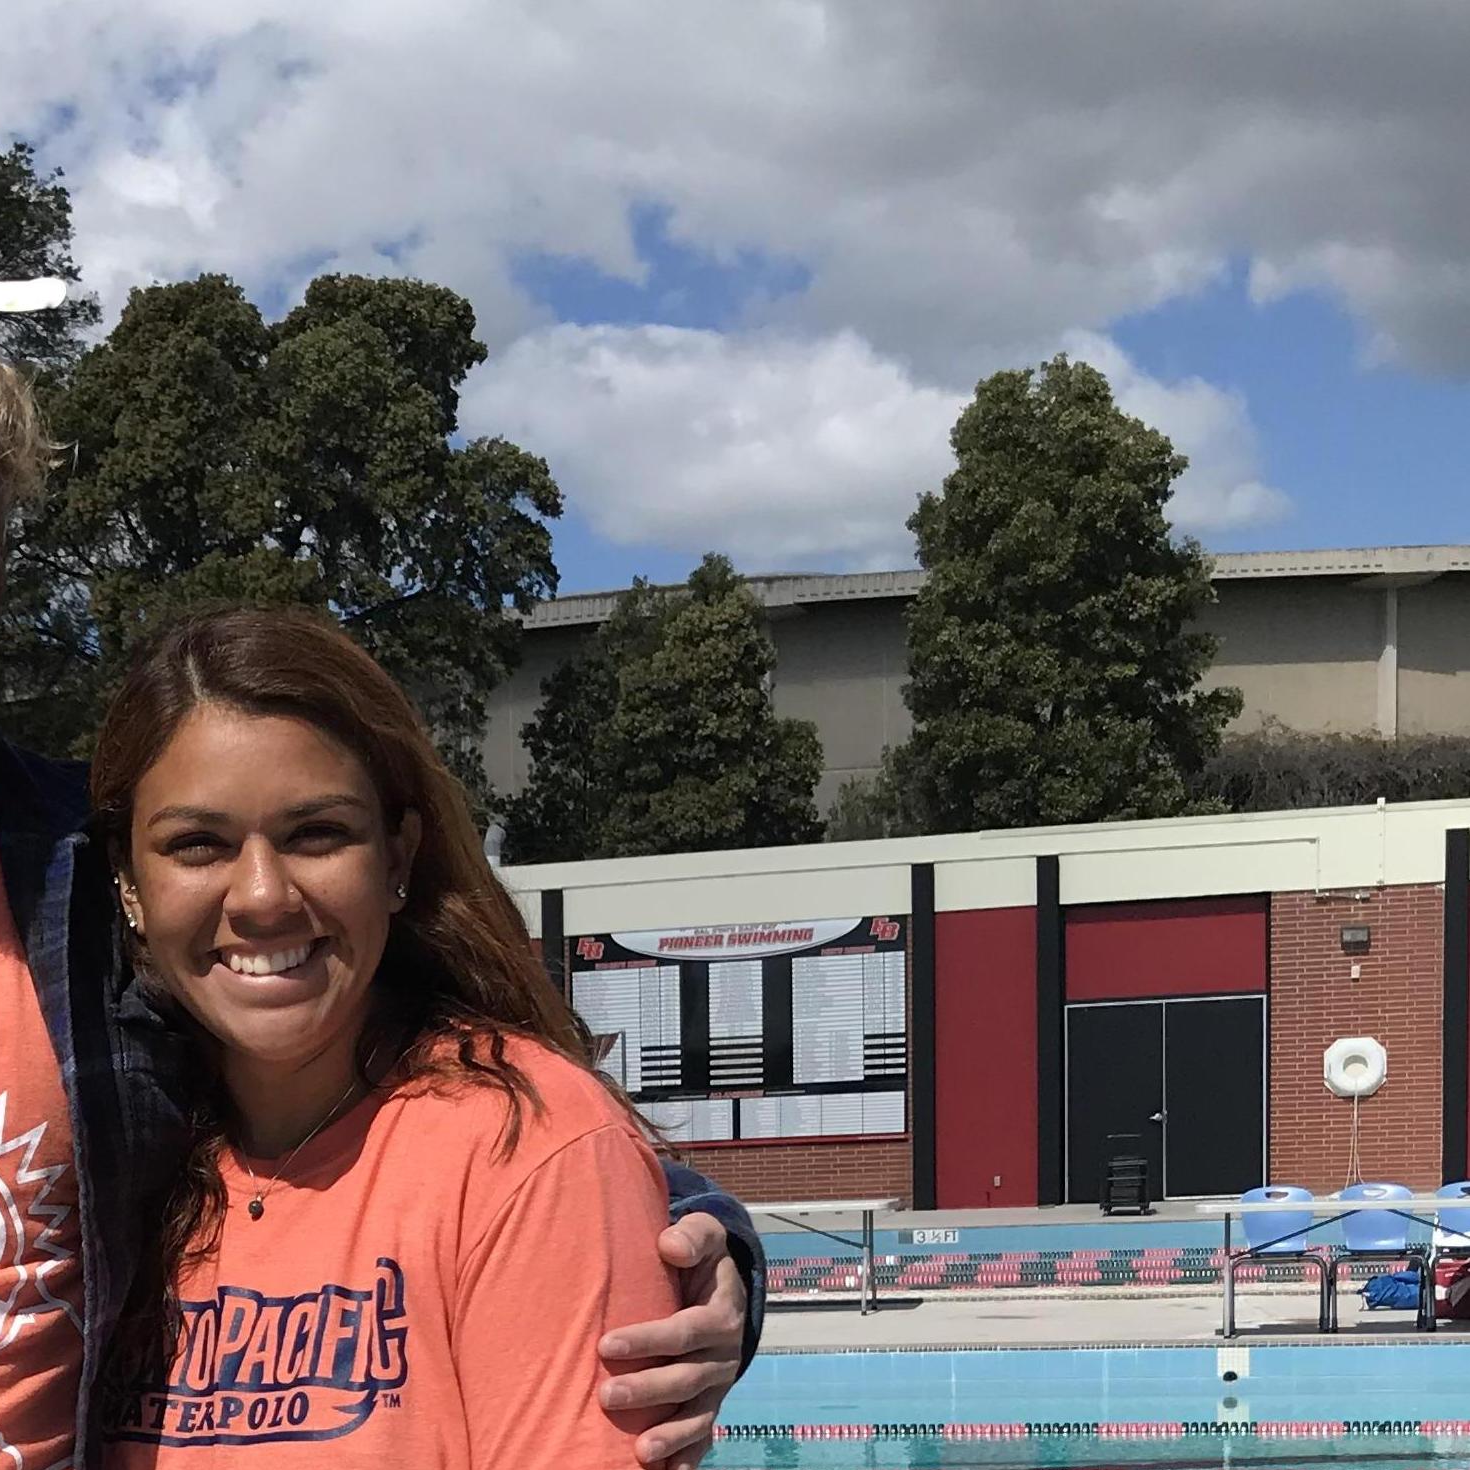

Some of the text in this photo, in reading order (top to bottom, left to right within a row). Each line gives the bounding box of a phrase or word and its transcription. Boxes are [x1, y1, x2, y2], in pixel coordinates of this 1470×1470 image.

[658, 927, 815, 951] PIONEER SWIMMING
[916, 1230, 926, 1244] 3
[944, 1230, 958, 1243] FT
